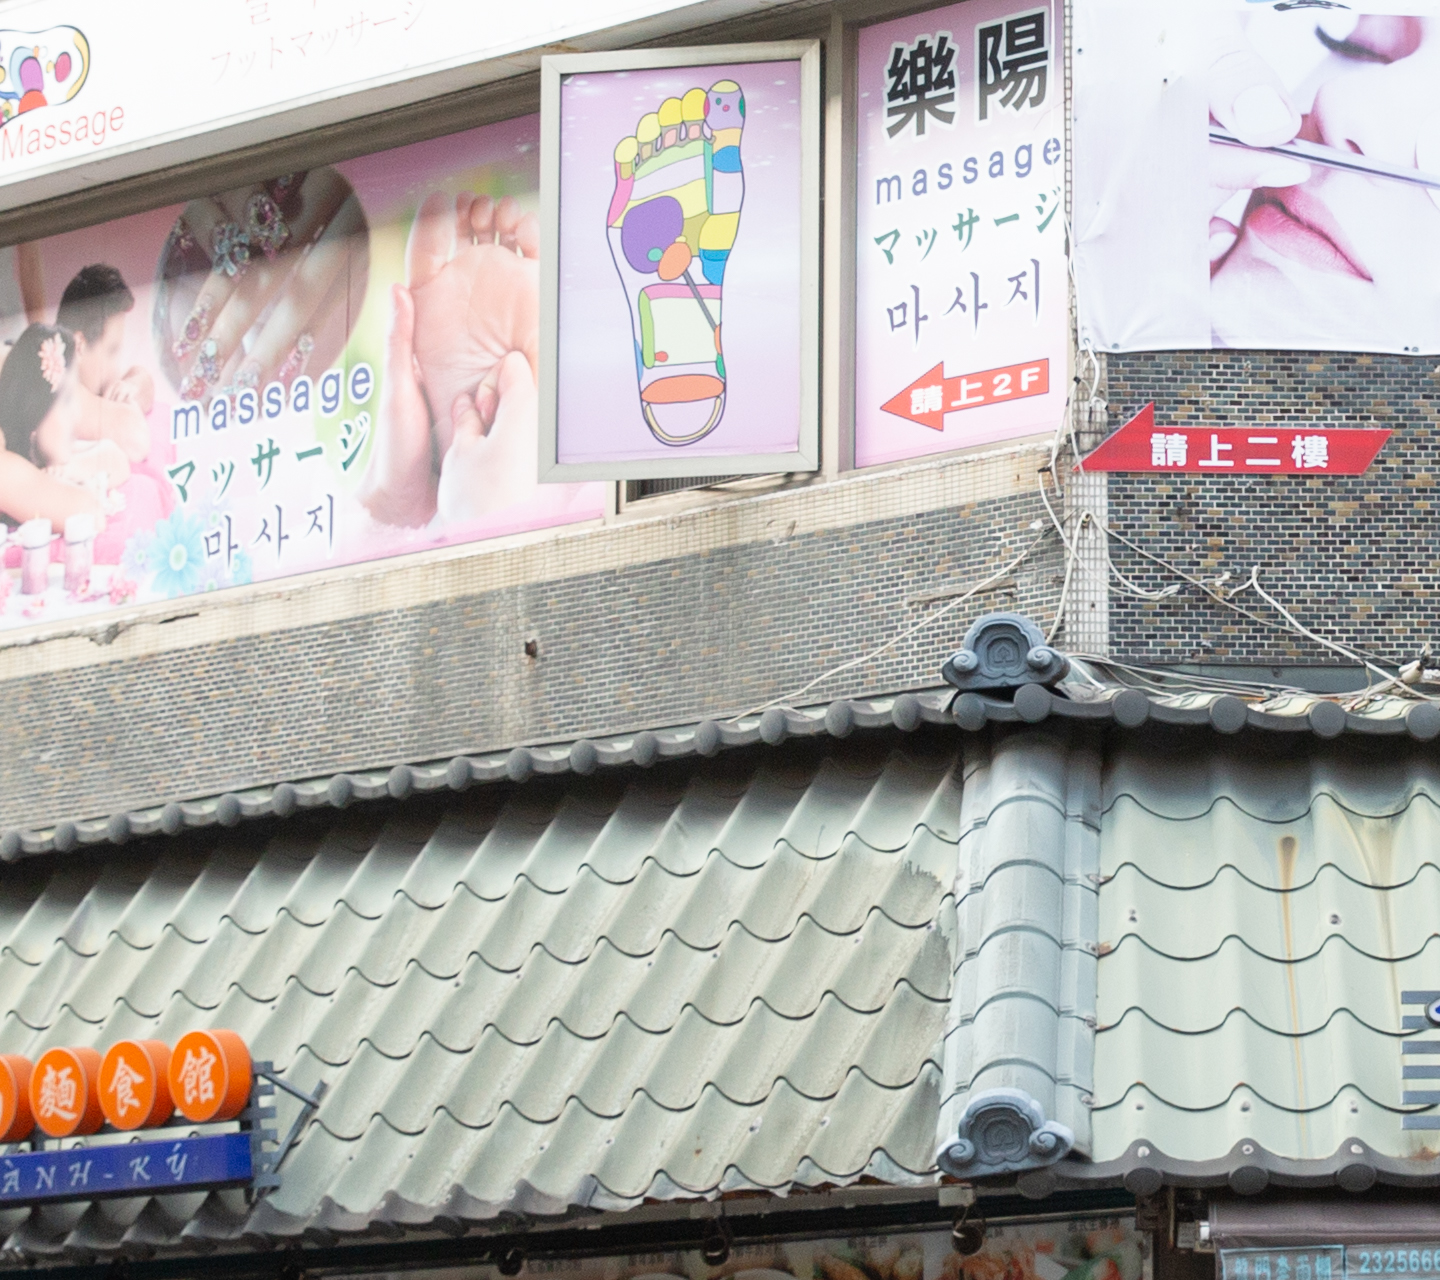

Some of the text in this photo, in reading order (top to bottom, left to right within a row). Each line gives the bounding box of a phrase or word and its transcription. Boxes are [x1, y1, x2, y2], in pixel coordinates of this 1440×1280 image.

[884, 6, 1052, 142] 樂陽
[0, 102, 126, 164] Massage
[875, 133, 1063, 207] massage
[872, 186, 1063, 269] マッサージ
[885, 257, 1045, 346] 마사지
[172, 363, 373, 442] massage
[167, 415, 373, 505] マッサージ
[1150, 429, 1332, 473] 請上二樓
[202, 494, 336, 572] 마사지
